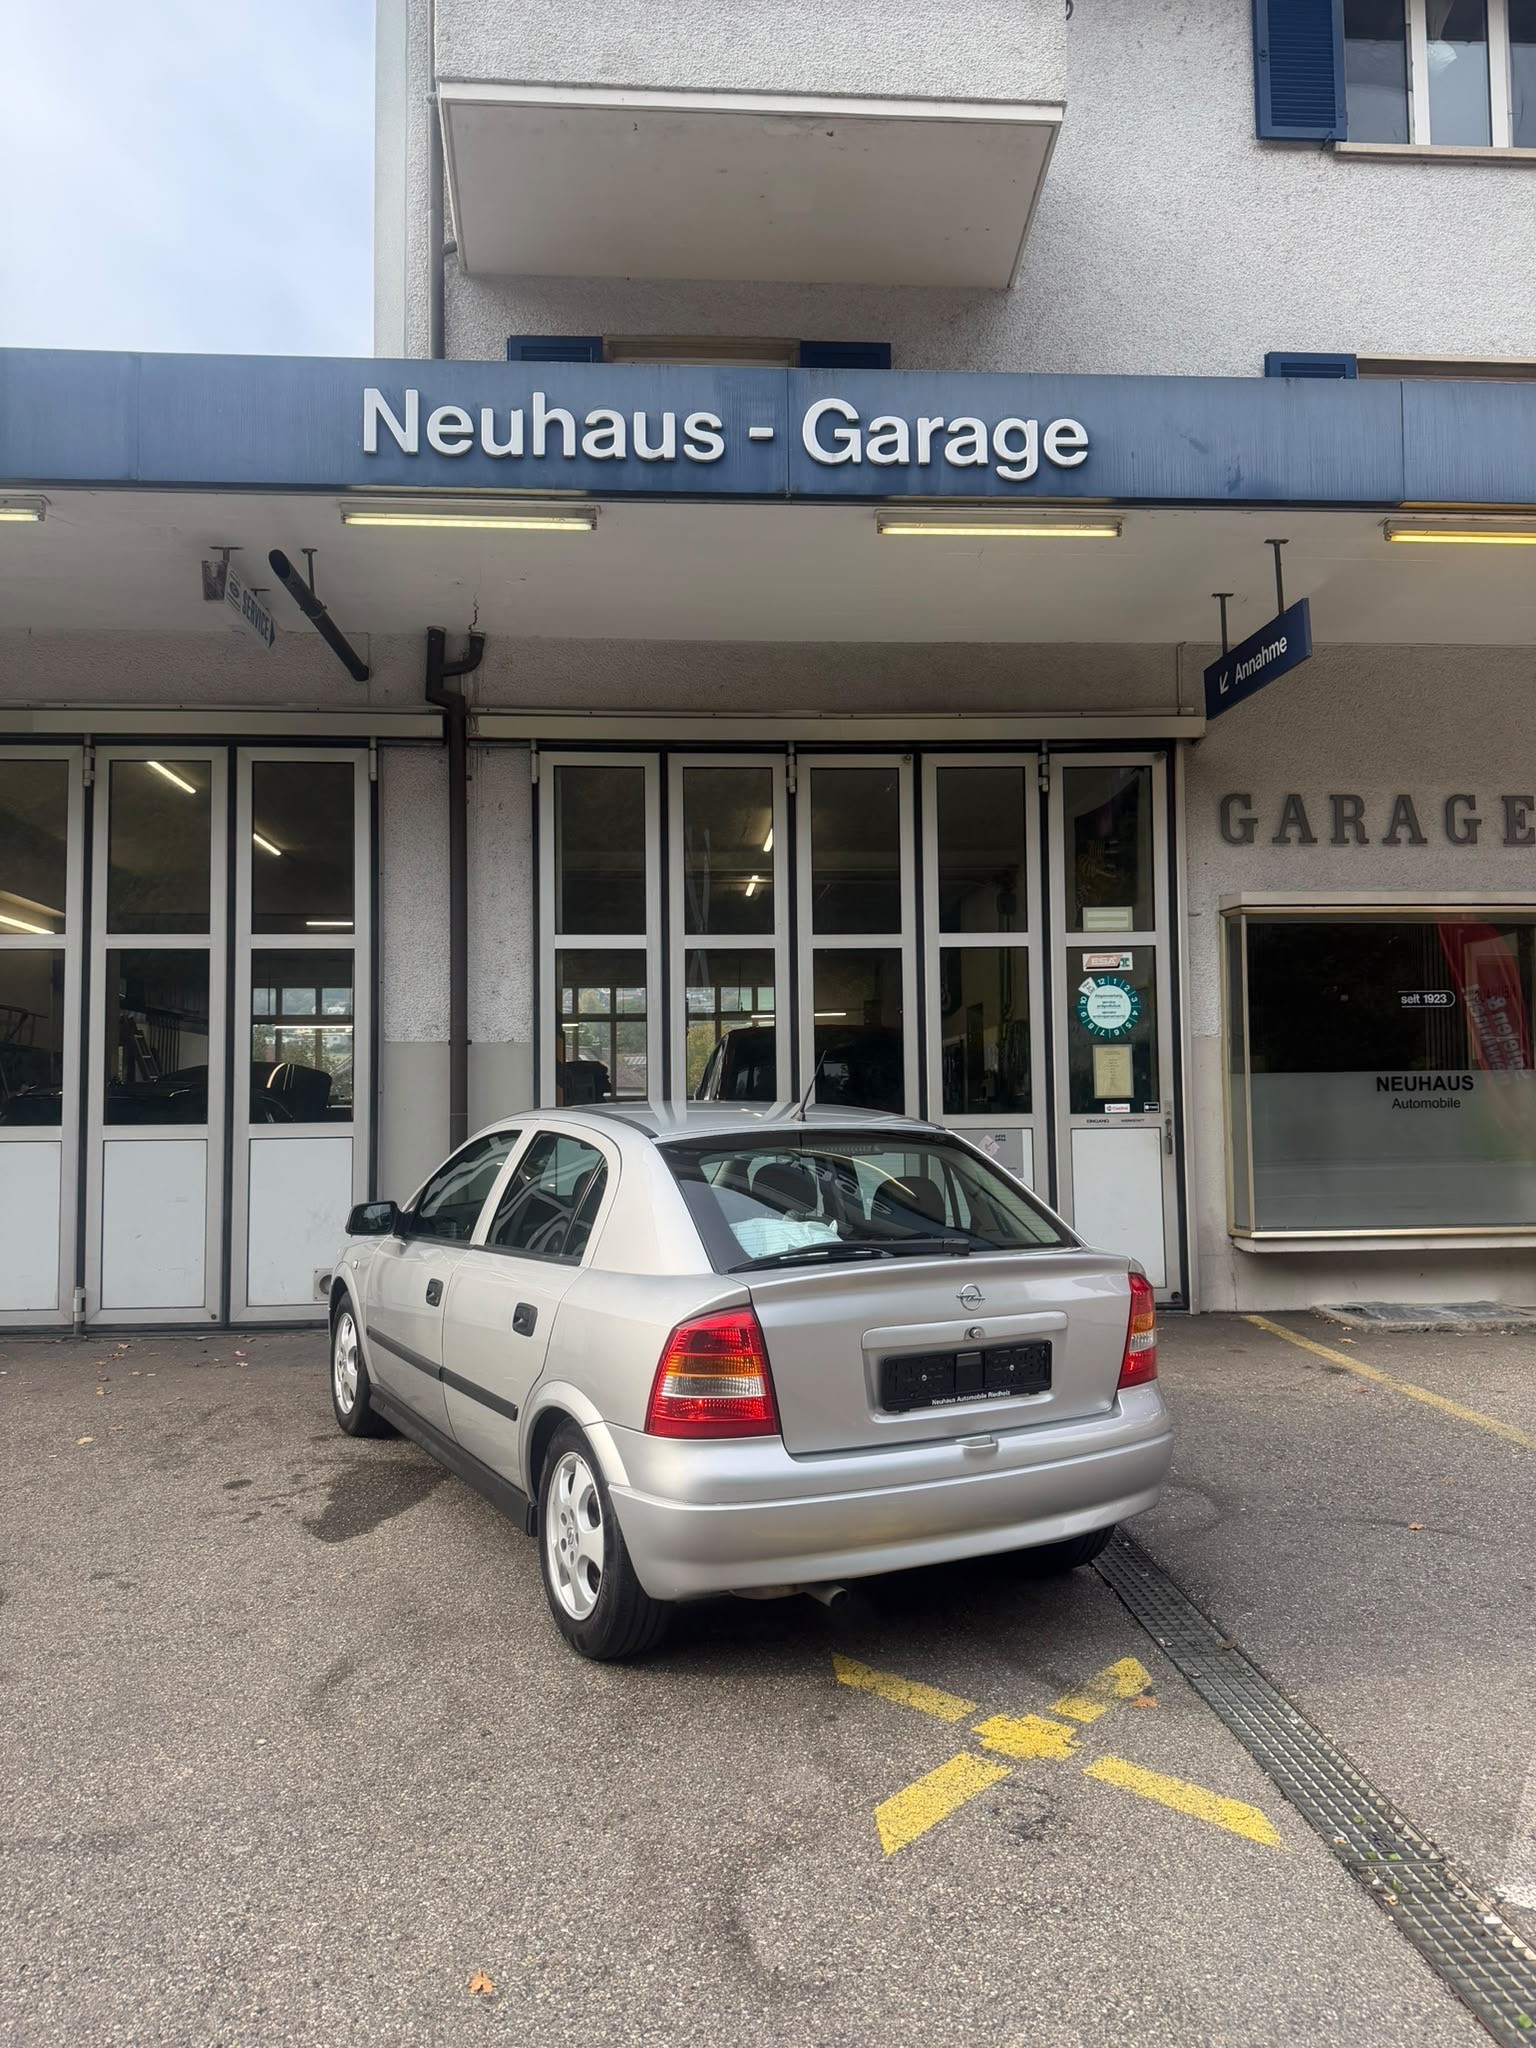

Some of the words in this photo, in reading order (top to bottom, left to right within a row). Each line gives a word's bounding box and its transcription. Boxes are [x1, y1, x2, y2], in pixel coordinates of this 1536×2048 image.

[363, 387, 726, 463] Neuhaus
[748, 427, 773, 440] -
[802, 397, 1089, 482] Garage
[242, 589, 270, 642] SERVICE
[1235, 636, 1288, 684] Annahme
[1219, 793, 1536, 845] GARAGE
[1401, 993, 1420, 1004] seit
[1422, 993, 1447, 1004] 1923
[1376, 1075, 1475, 1092] NEUHAUS
[1391, 1097, 1461, 1110] Automobile
[931, 1397, 956, 1406] Neuhaus
[956, 1393, 987, 1402] Automobile
[987, 1389, 1011, 1398] Riedholz
